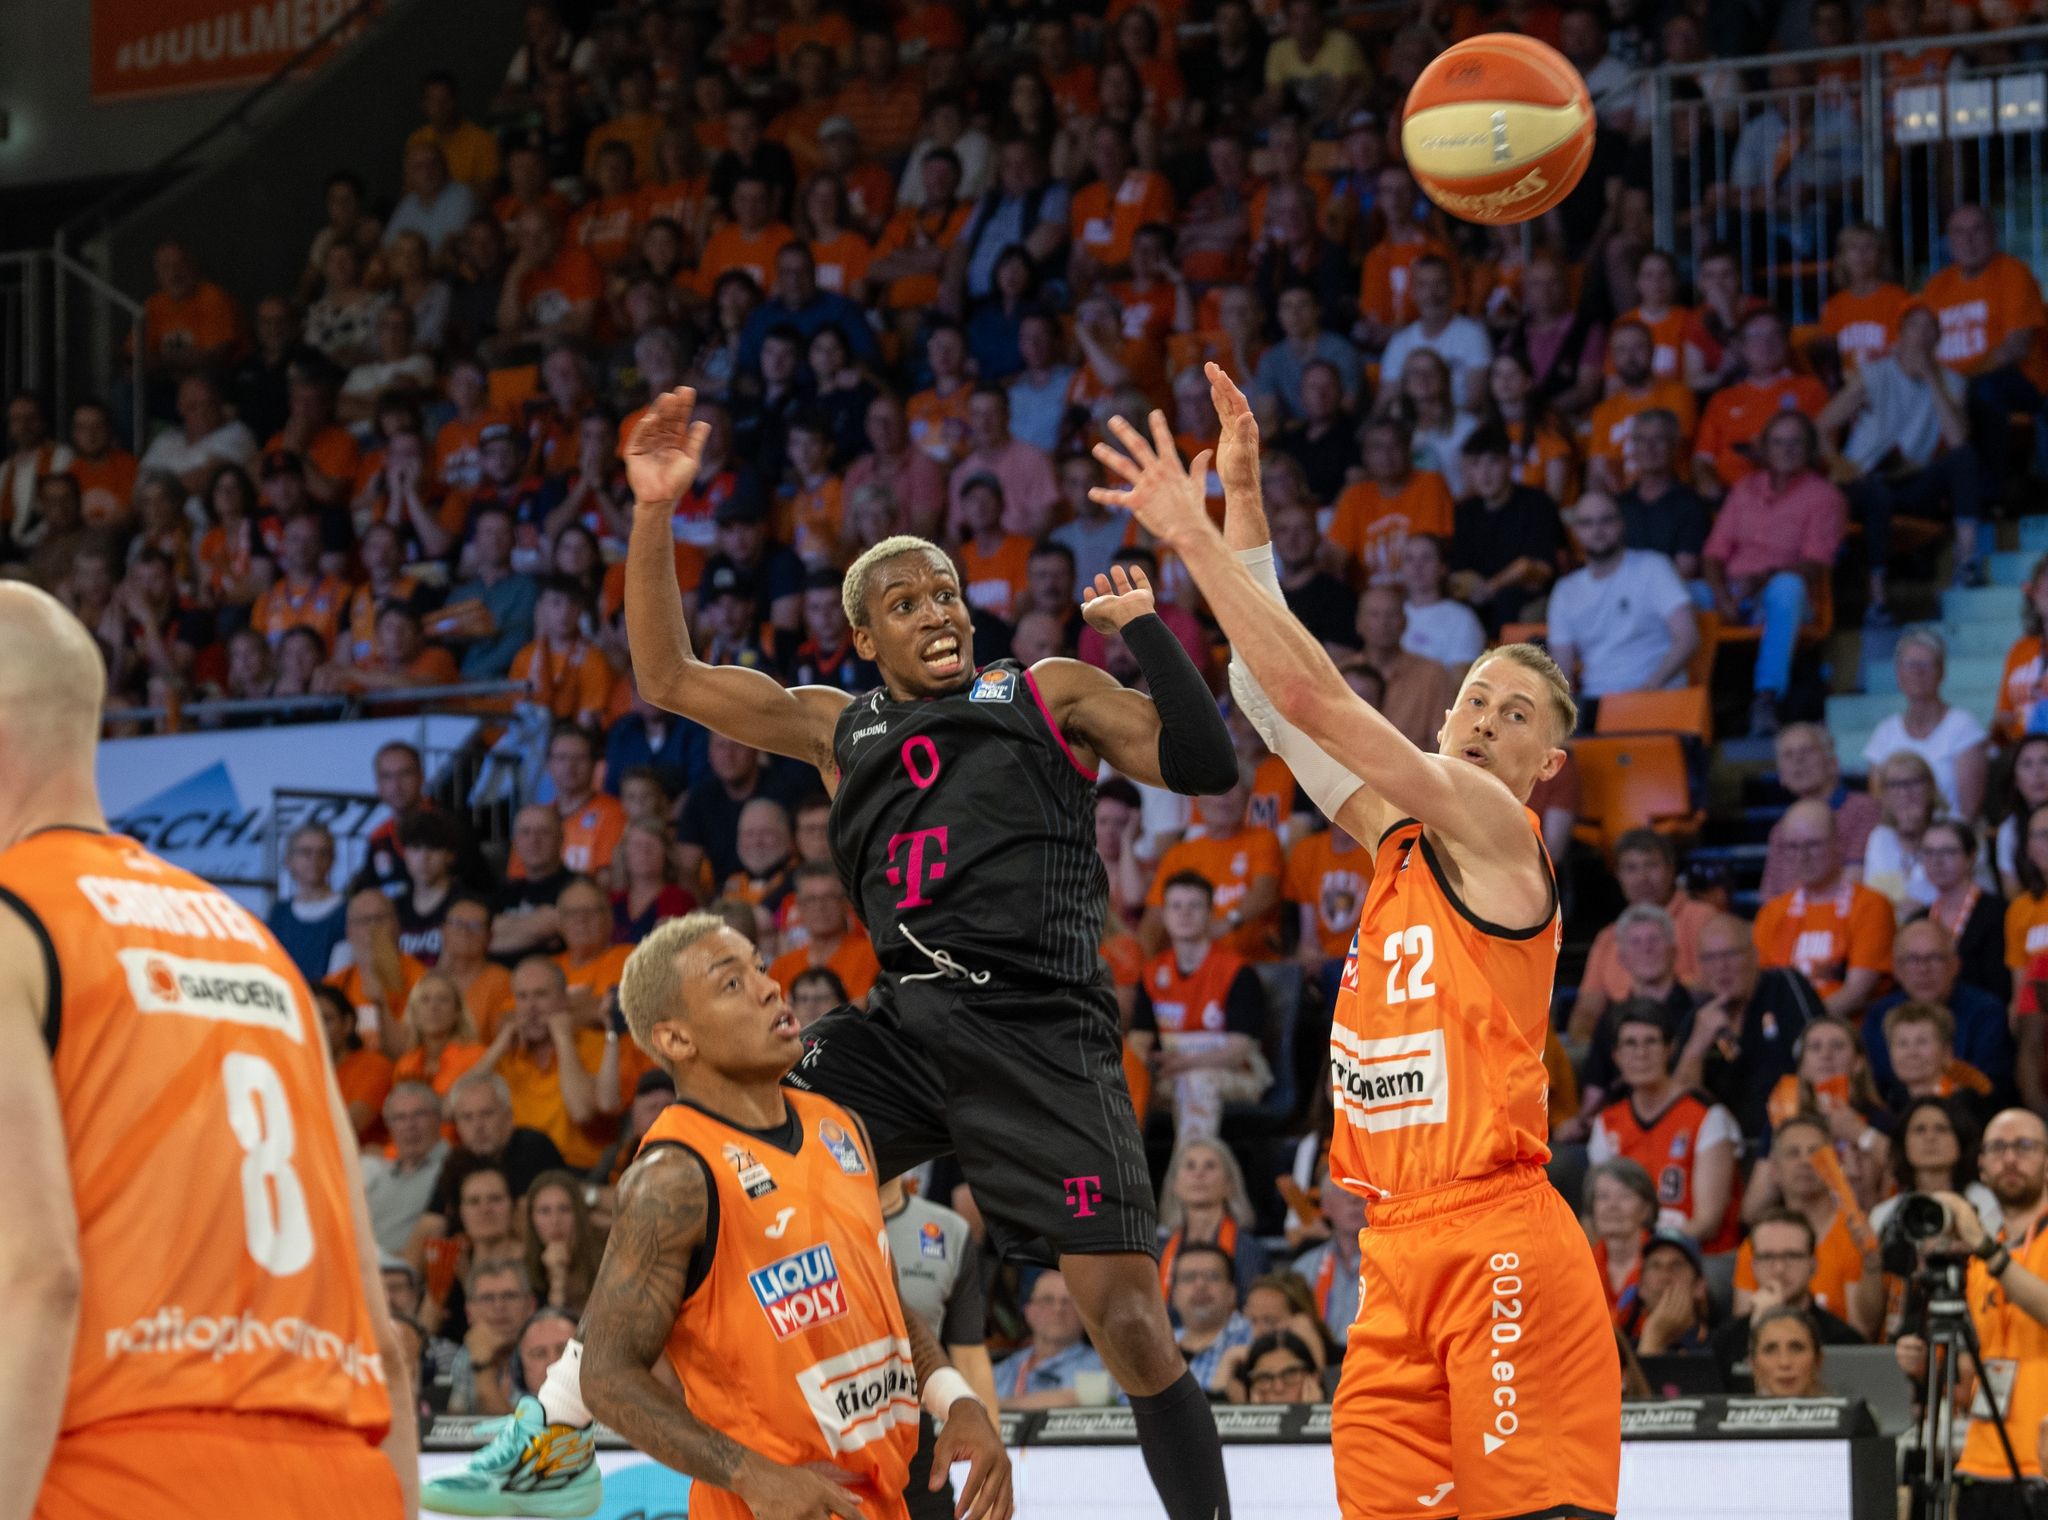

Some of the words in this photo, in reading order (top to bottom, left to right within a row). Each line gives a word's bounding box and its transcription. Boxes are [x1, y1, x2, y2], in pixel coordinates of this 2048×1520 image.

[852, 721, 887, 746] SPALDING
[901, 735, 939, 788] 0
[1383, 925, 1437, 1005] 22
[221, 1050, 316, 1277] 8
[755, 1247, 835, 1305] LIQUI
[769, 1280, 840, 1335] MOLY
[1489, 1252, 1522, 1436] 8020.eco
